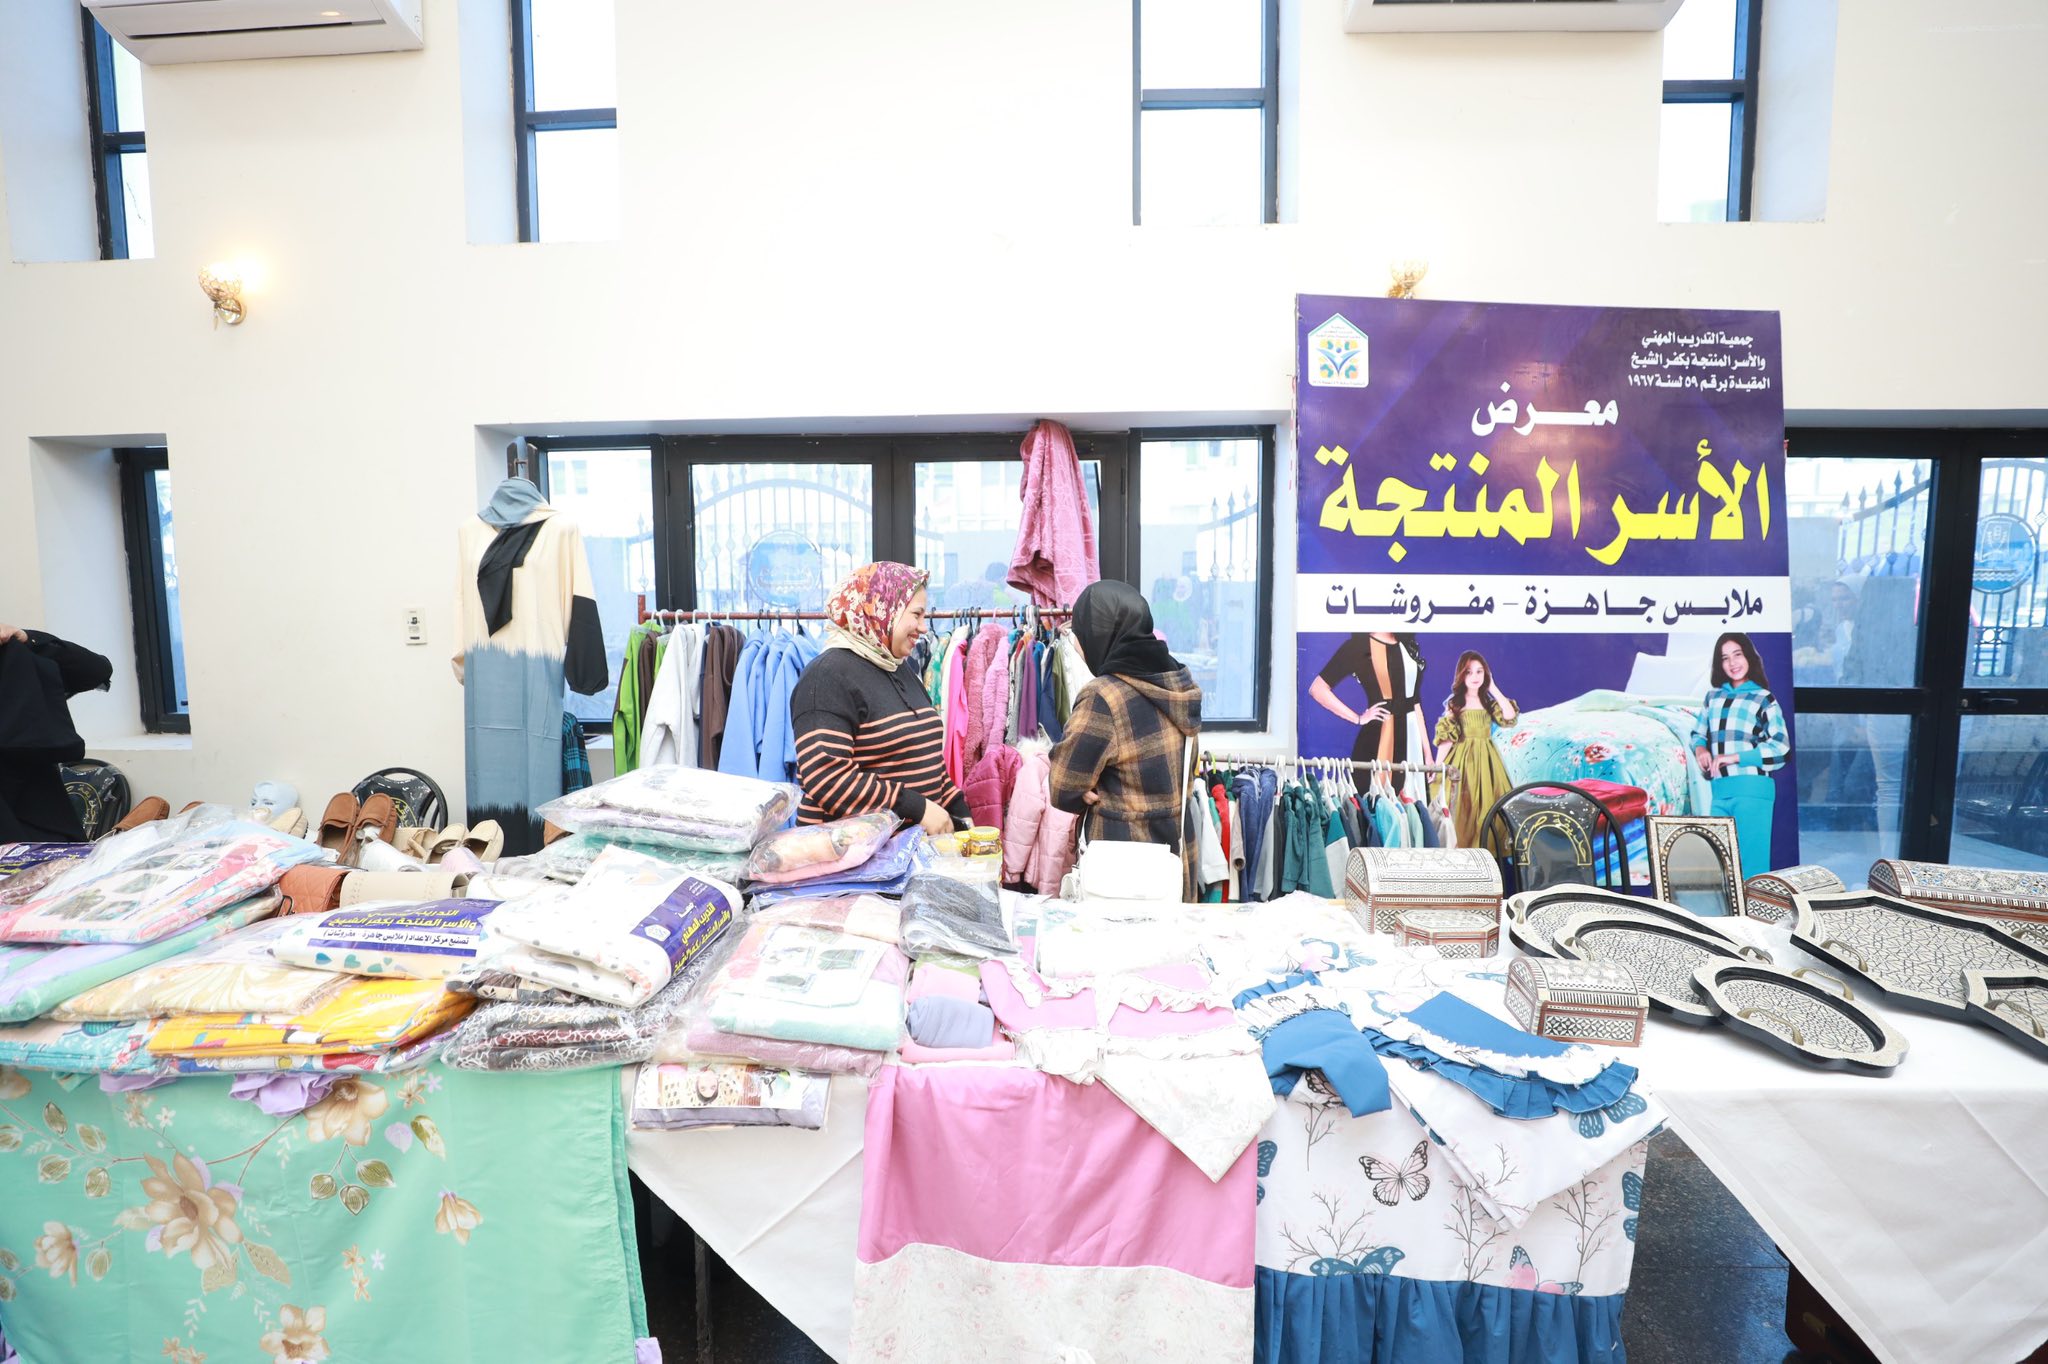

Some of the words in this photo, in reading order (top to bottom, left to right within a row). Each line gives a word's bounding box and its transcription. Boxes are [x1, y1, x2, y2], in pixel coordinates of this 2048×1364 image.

[1641, 330, 1675, 348] المهني
[1677, 332, 1719, 348] التدريب
[1720, 332, 1753, 348] جمعية
[1631, 351, 1662, 369] الشيخ
[1663, 352, 1690, 369] بكفر
[1691, 352, 1730, 370] المنتجة
[1731, 352, 1766, 370] والأسر
[1628, 374, 1654, 387] ١٩٦٧
[1656, 374, 1683, 388] لسنة
[1685, 376, 1699, 388] ٥٩
[1700, 374, 1728, 392] برقم
[1729, 375, 1770, 392] المقيدة
[1471, 382, 1619, 436] معرض
[1314, 445, 1581, 564] المنتجة
[1586, 439, 1770, 566] الأسر
[1325, 584, 1495, 623] مفروشات
[1525, 584, 1656, 623] جاهزة
[1662, 588, 1763, 626] ملابس
[365, 917, 394, 927] بكفر
[396, 917, 442, 928] المنتجة
